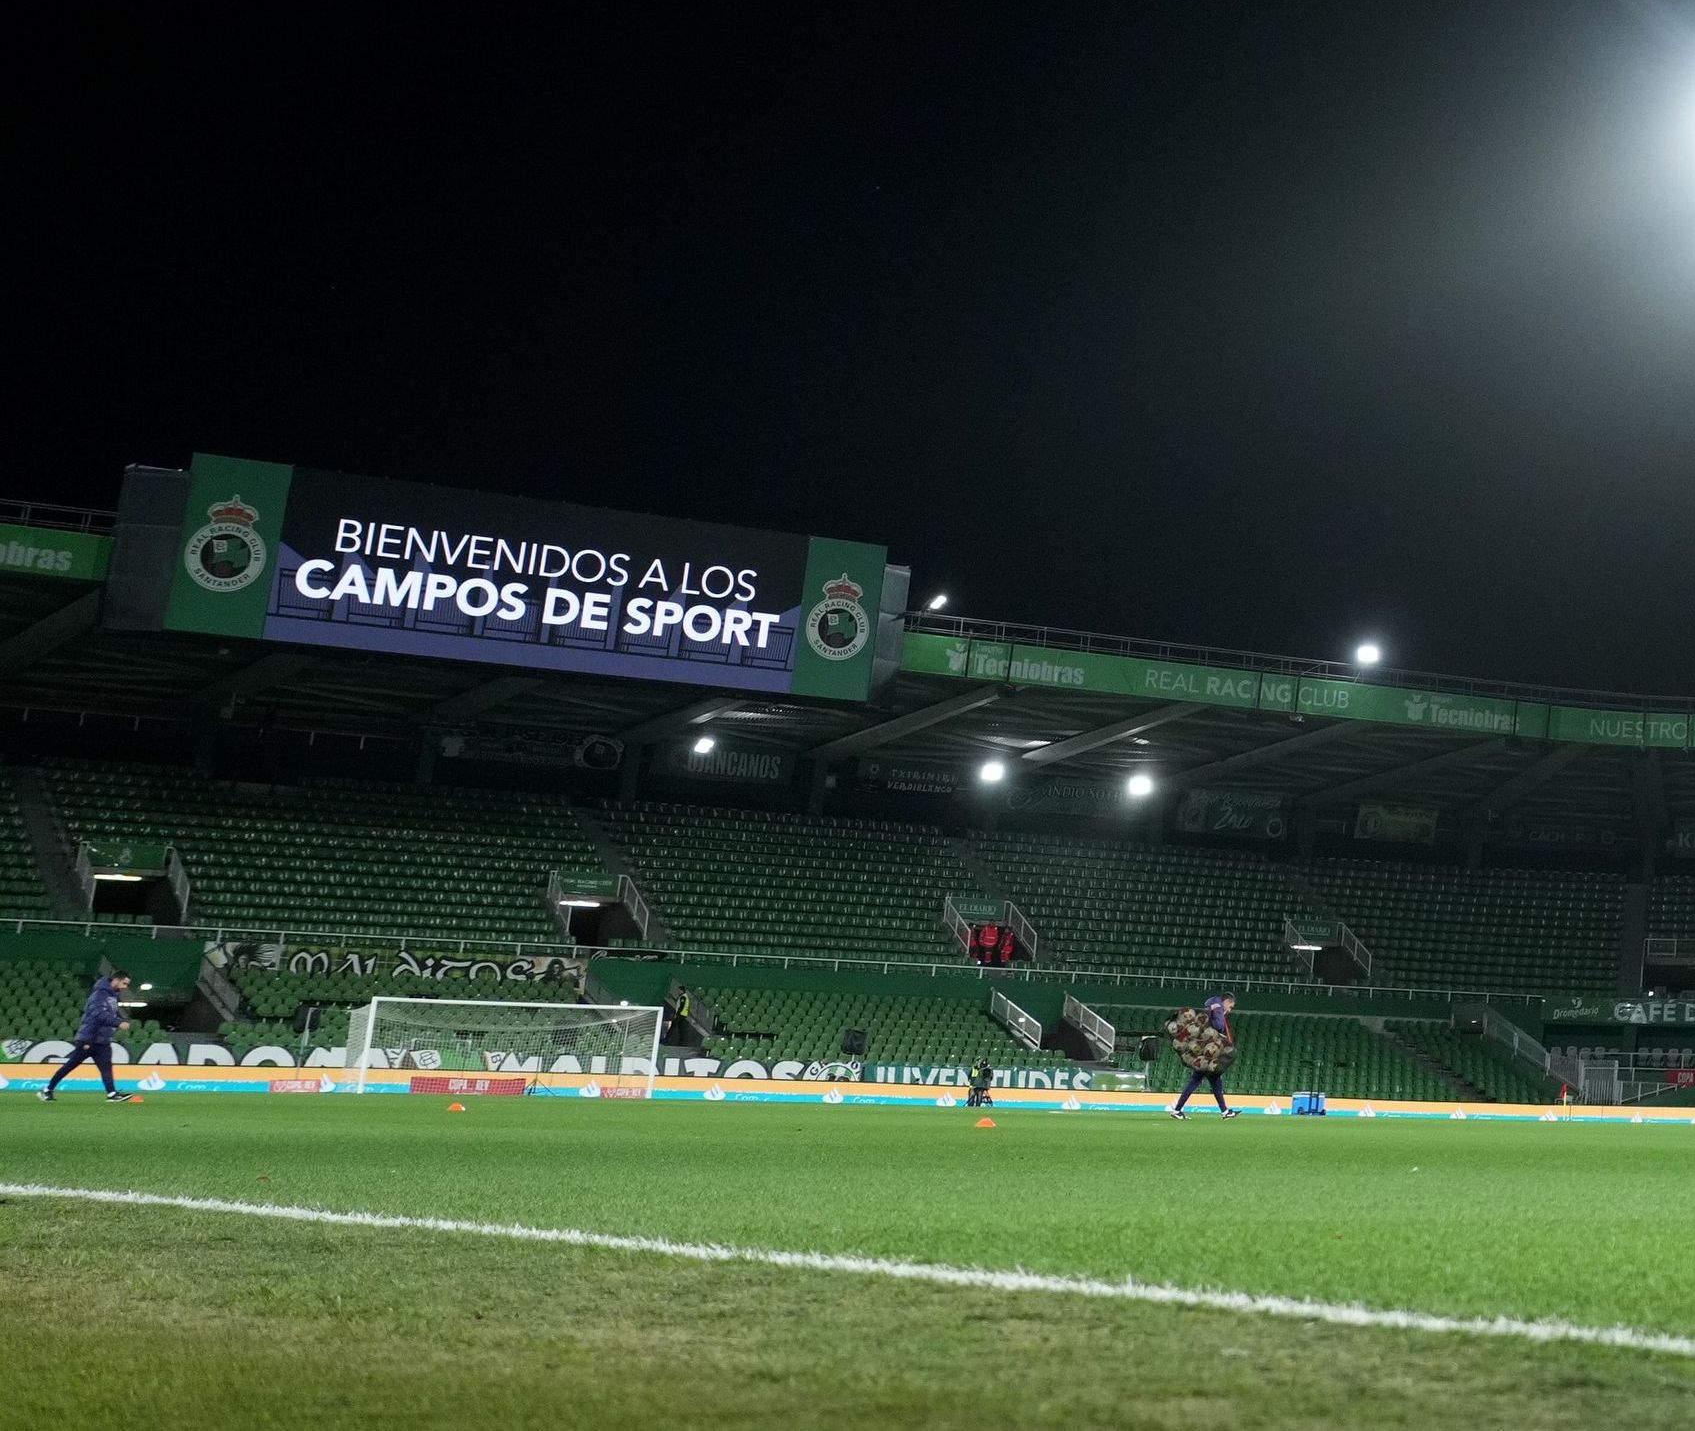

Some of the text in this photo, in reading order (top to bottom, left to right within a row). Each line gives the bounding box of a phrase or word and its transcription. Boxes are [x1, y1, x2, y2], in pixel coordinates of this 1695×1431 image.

[334, 517, 757, 602] BIENVENIDOS A LOS
[194, 568, 250, 587] SANTANDER
[295, 559, 780, 649] CAMPOS DE SPORT
[825, 601, 856, 612] RACING
[813, 639, 857, 656] SANTANDER
[974, 651, 1085, 686] Tecniobras
[1145, 669, 1350, 709] REAL RACING CLUB
[1429, 704, 1520, 733] Tecniobras
[1589, 718, 1687, 741] NUESTRO
[1553, 1006, 1599, 1019] Dromedario
[22, 1040, 392, 1069] GADONA
